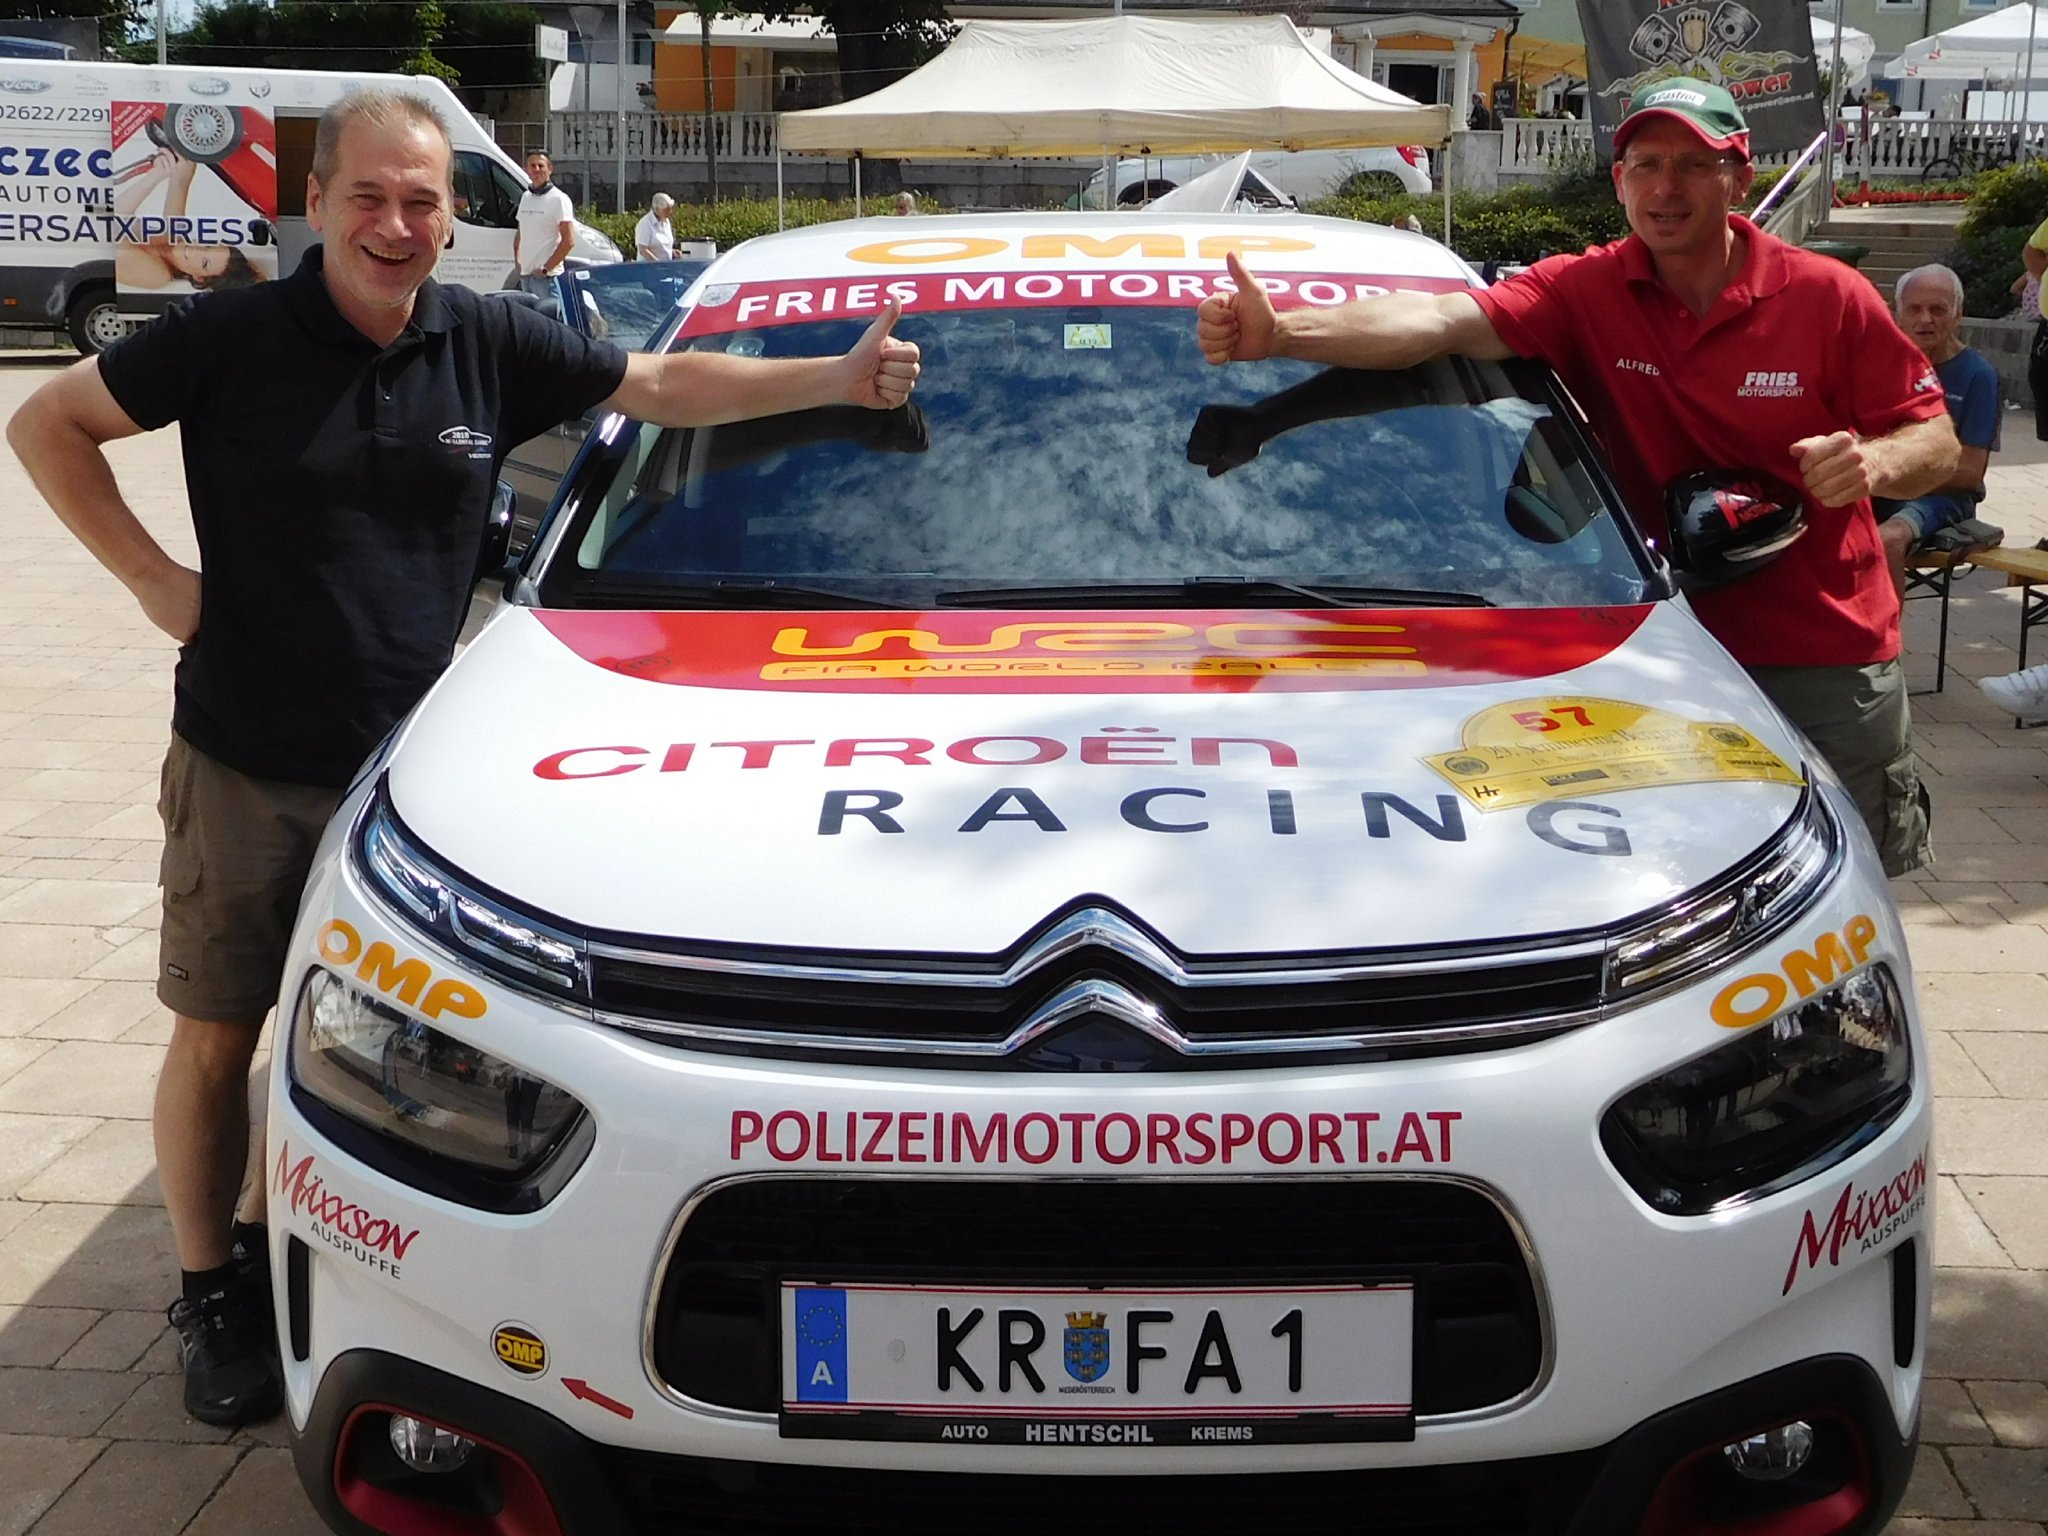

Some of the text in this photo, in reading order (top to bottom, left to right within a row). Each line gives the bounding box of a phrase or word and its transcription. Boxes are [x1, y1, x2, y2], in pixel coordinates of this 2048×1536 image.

[846, 234, 1316, 265] OMP
[736, 280, 919, 323] FRIES
[1616, 358, 1660, 376] ALFRED
[1745, 371, 1799, 386] FRIES
[1737, 386, 1804, 397] MOTORSPORT
[782, 664, 877, 674] FIA
[904, 662, 1145, 671] WORLD
[1511, 706, 1595, 732] 57
[817, 786, 1633, 858] RACING
[317, 918, 488, 1020] OMP
[1709, 914, 1876, 1028] OMP
[730, 1110, 1462, 1165] POLIZEIMOTORSPORT.AT
[1860, 1190, 1926, 1254] AUSPUFFE
[311, 1221, 401, 1280] AUSPUFFE
[497, 1337, 544, 1363] OMP
[937, 1307, 1303, 1394] KR FA 1
[810, 1360, 834, 1386] A
[1058, 1384, 1116, 1395] NIEDERÖSTERREICH
[941, 1424, 1254, 1443] AUTO HENTSCHL KREMS
